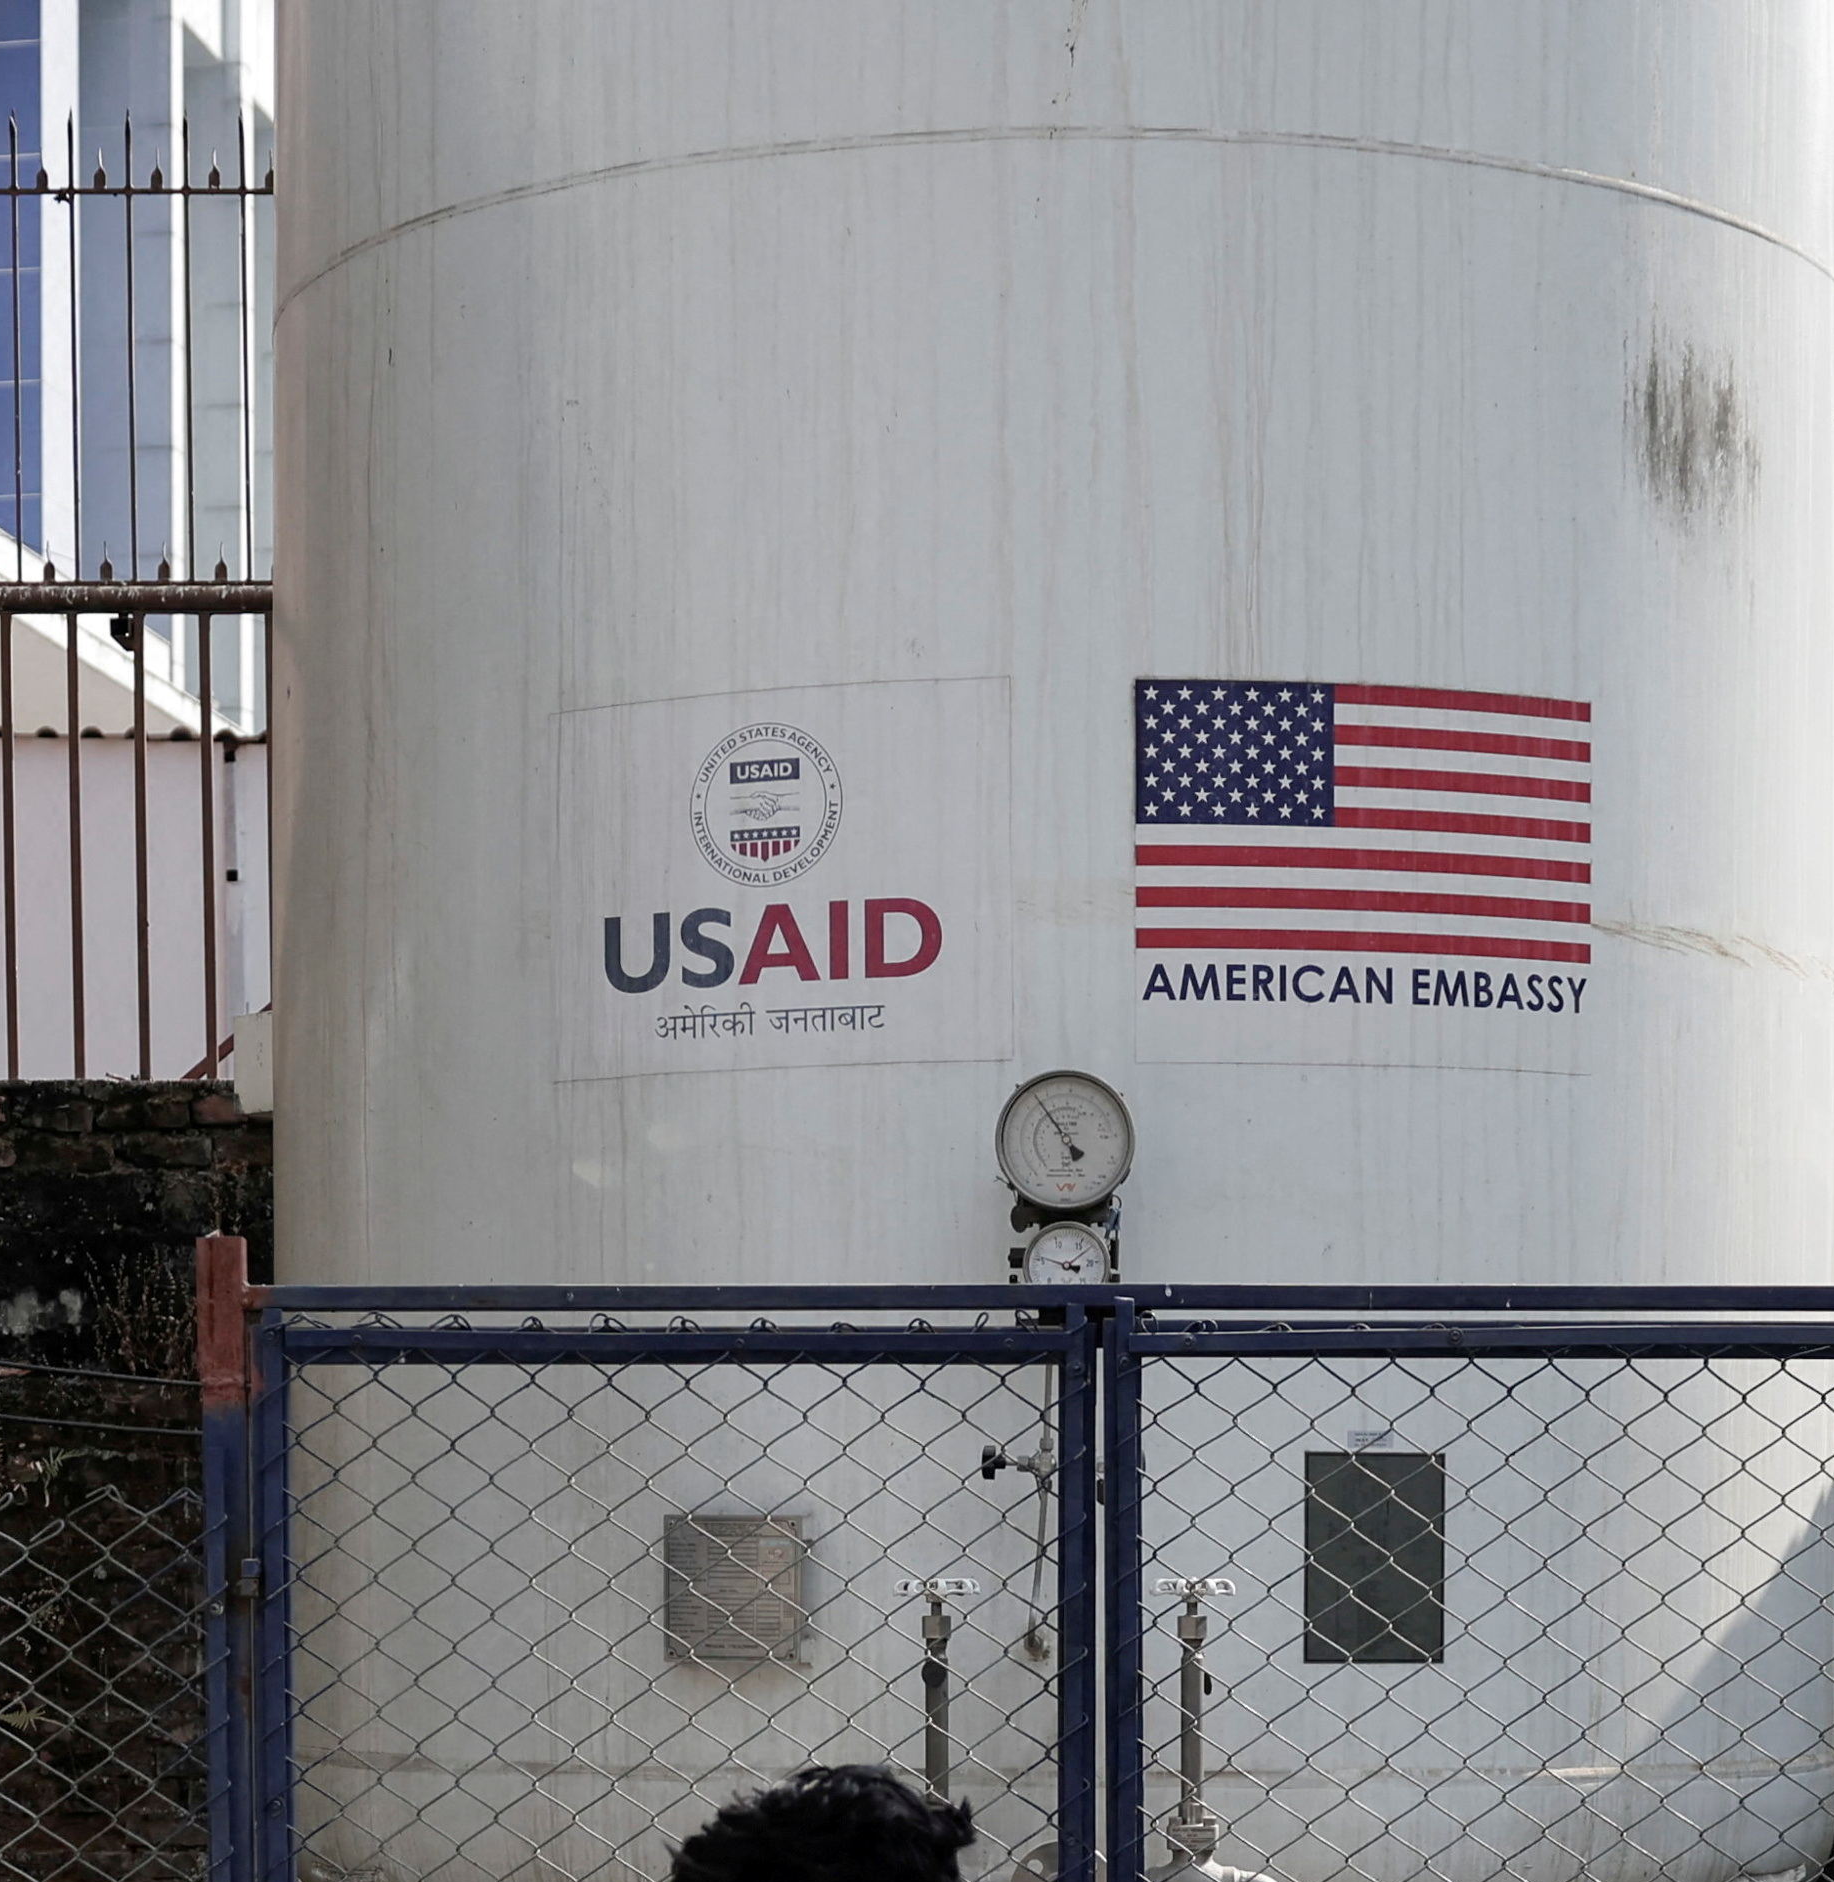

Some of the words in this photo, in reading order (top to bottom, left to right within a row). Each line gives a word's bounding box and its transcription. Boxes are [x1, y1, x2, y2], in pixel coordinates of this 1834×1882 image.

[700, 738, 737, 783] UNITED
[739, 727, 786, 743] STATES
[788, 732, 833, 774] AGENCY
[736, 762, 792, 780] USAID
[693, 811, 770, 884] INTERNATIONAL
[773, 801, 839, 882] DEVELOPMENT
[604, 898, 943, 994] USAID
[1142, 963, 1393, 1005] AMERICAN
[1412, 968, 1587, 1014] EMBASSY
[654, 1001, 756, 1040] अमेरिकी
[766, 1004, 885, 1034] जनताबाट
[1075, 1241, 1083, 1250] 15
[1086, 1259, 1094, 1267] 20
